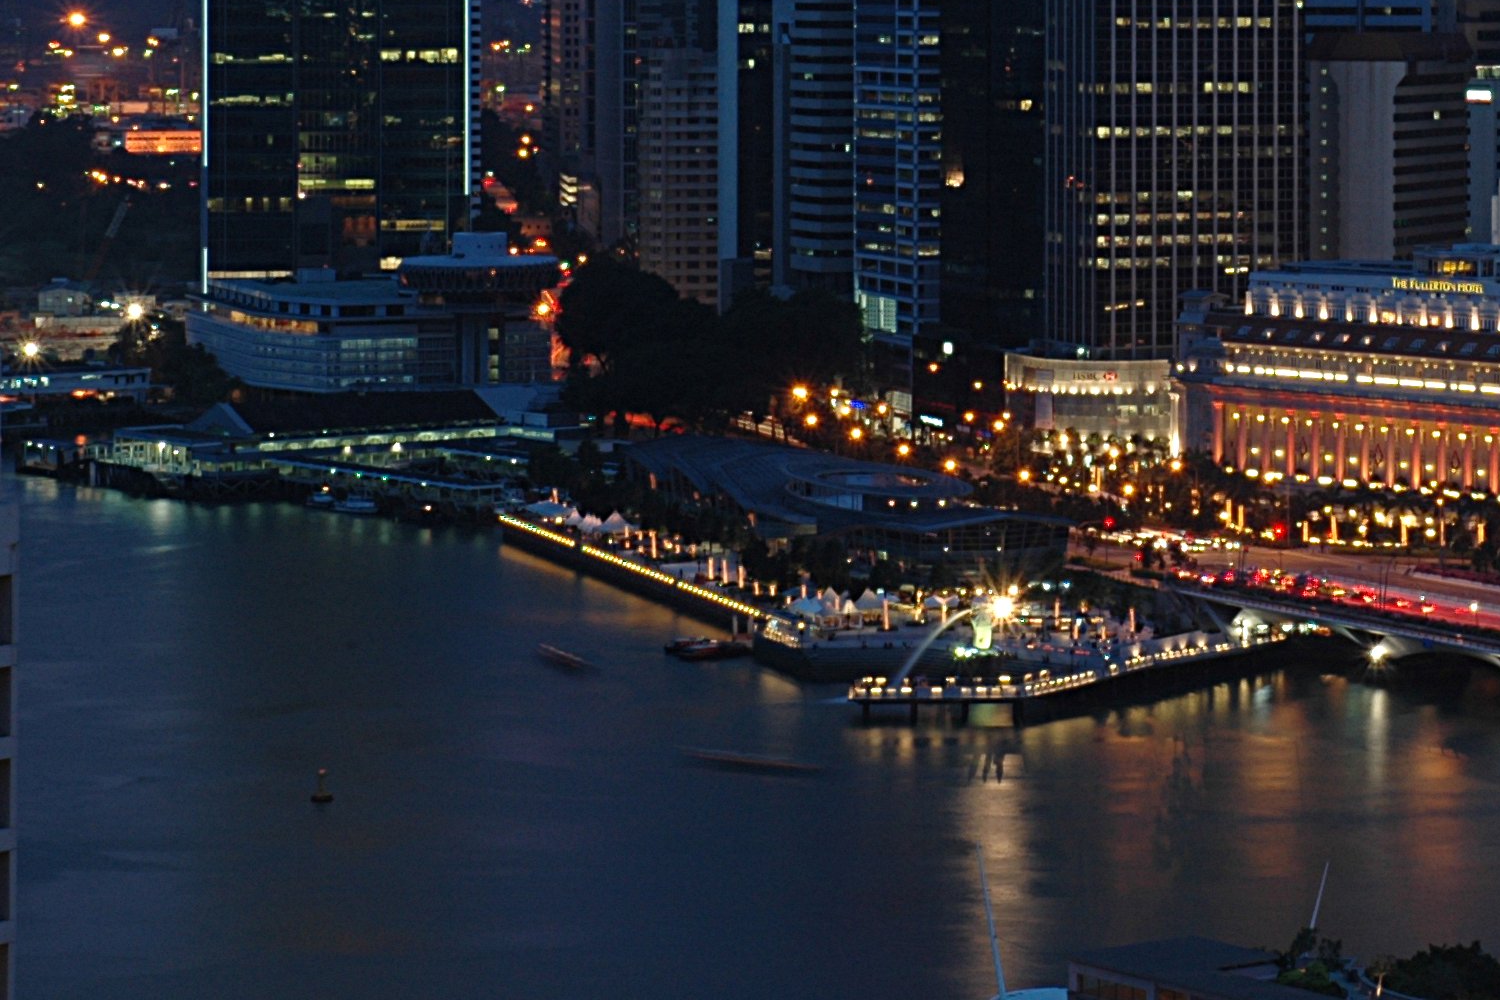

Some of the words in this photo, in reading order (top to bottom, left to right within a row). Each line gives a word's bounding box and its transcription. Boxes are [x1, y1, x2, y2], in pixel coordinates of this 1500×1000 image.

[1392, 277, 1408, 289] THE
[1409, 278, 1456, 292] FULLERTON
[1457, 282, 1484, 294] HOTEL
